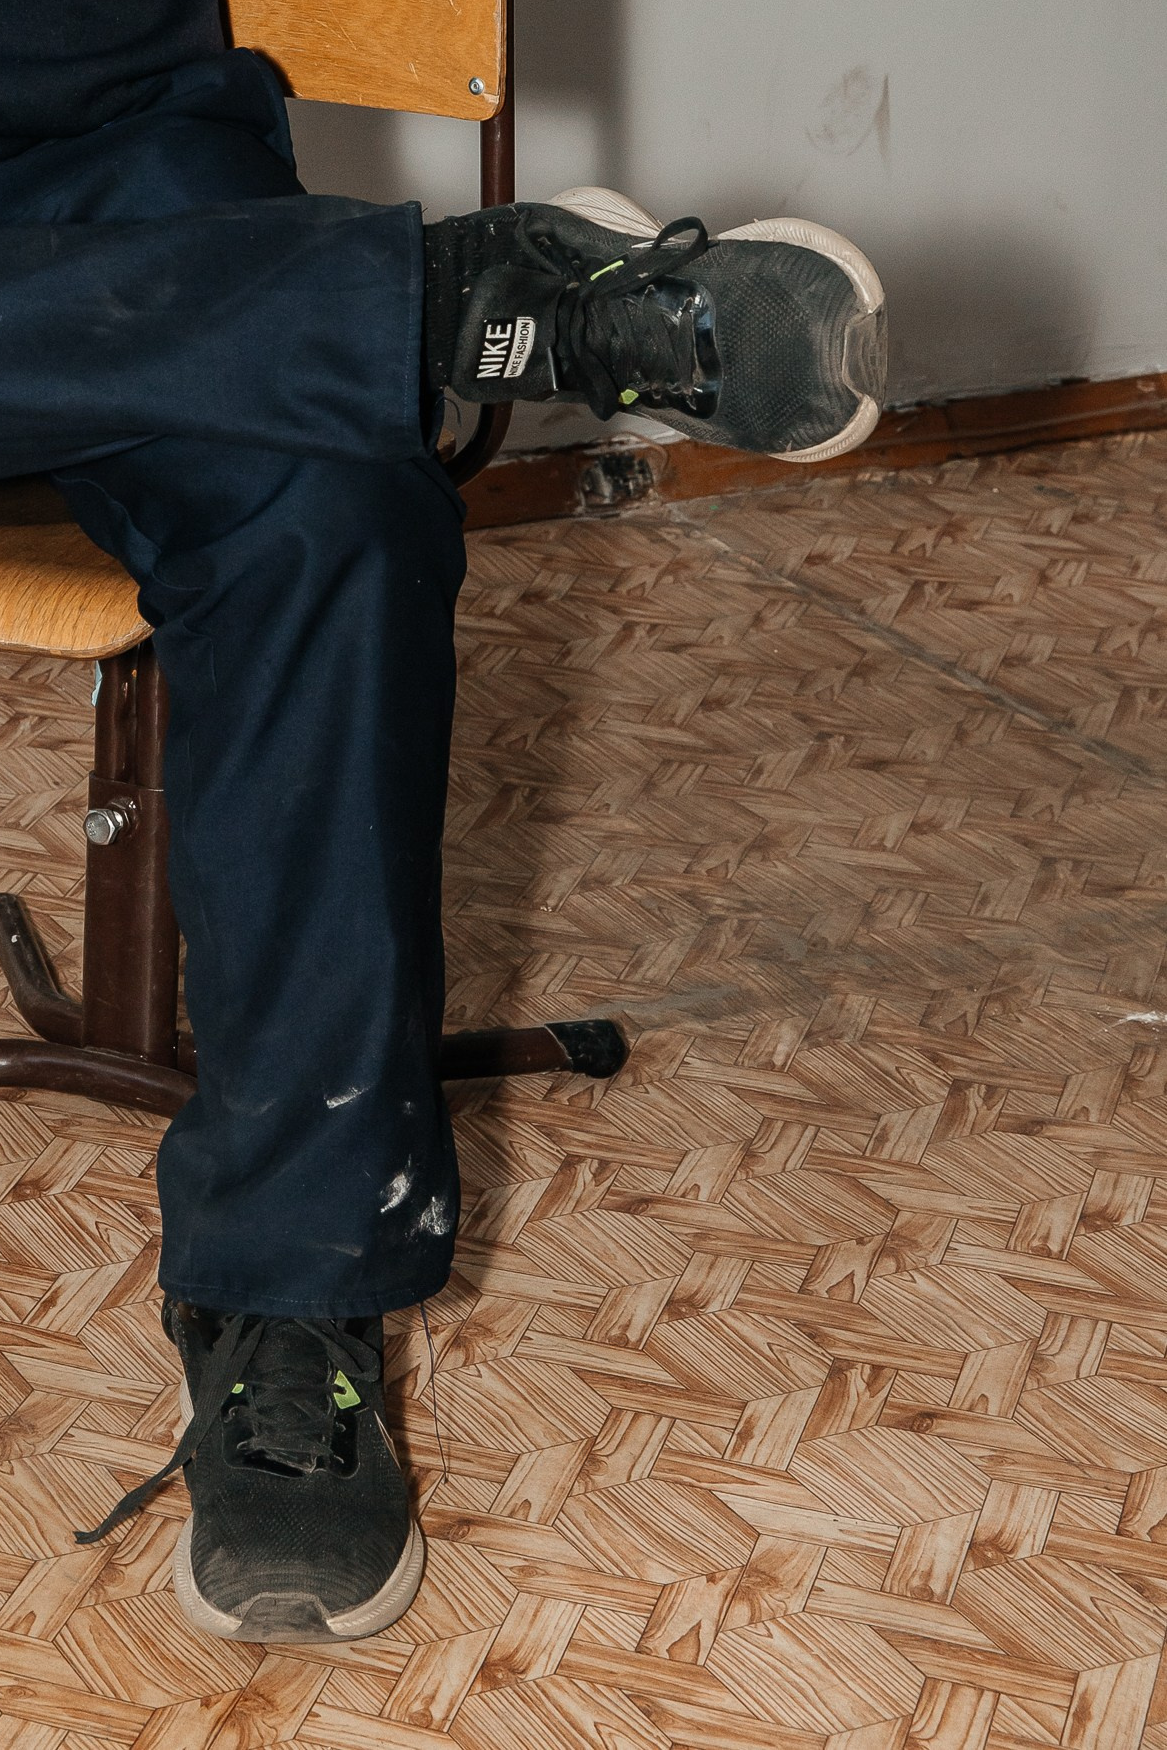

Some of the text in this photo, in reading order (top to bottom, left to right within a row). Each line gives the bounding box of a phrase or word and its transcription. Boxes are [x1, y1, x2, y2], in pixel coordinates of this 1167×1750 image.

[476, 323, 512, 378] NIKE
[508, 321, 531, 376] NIKE FASHION
